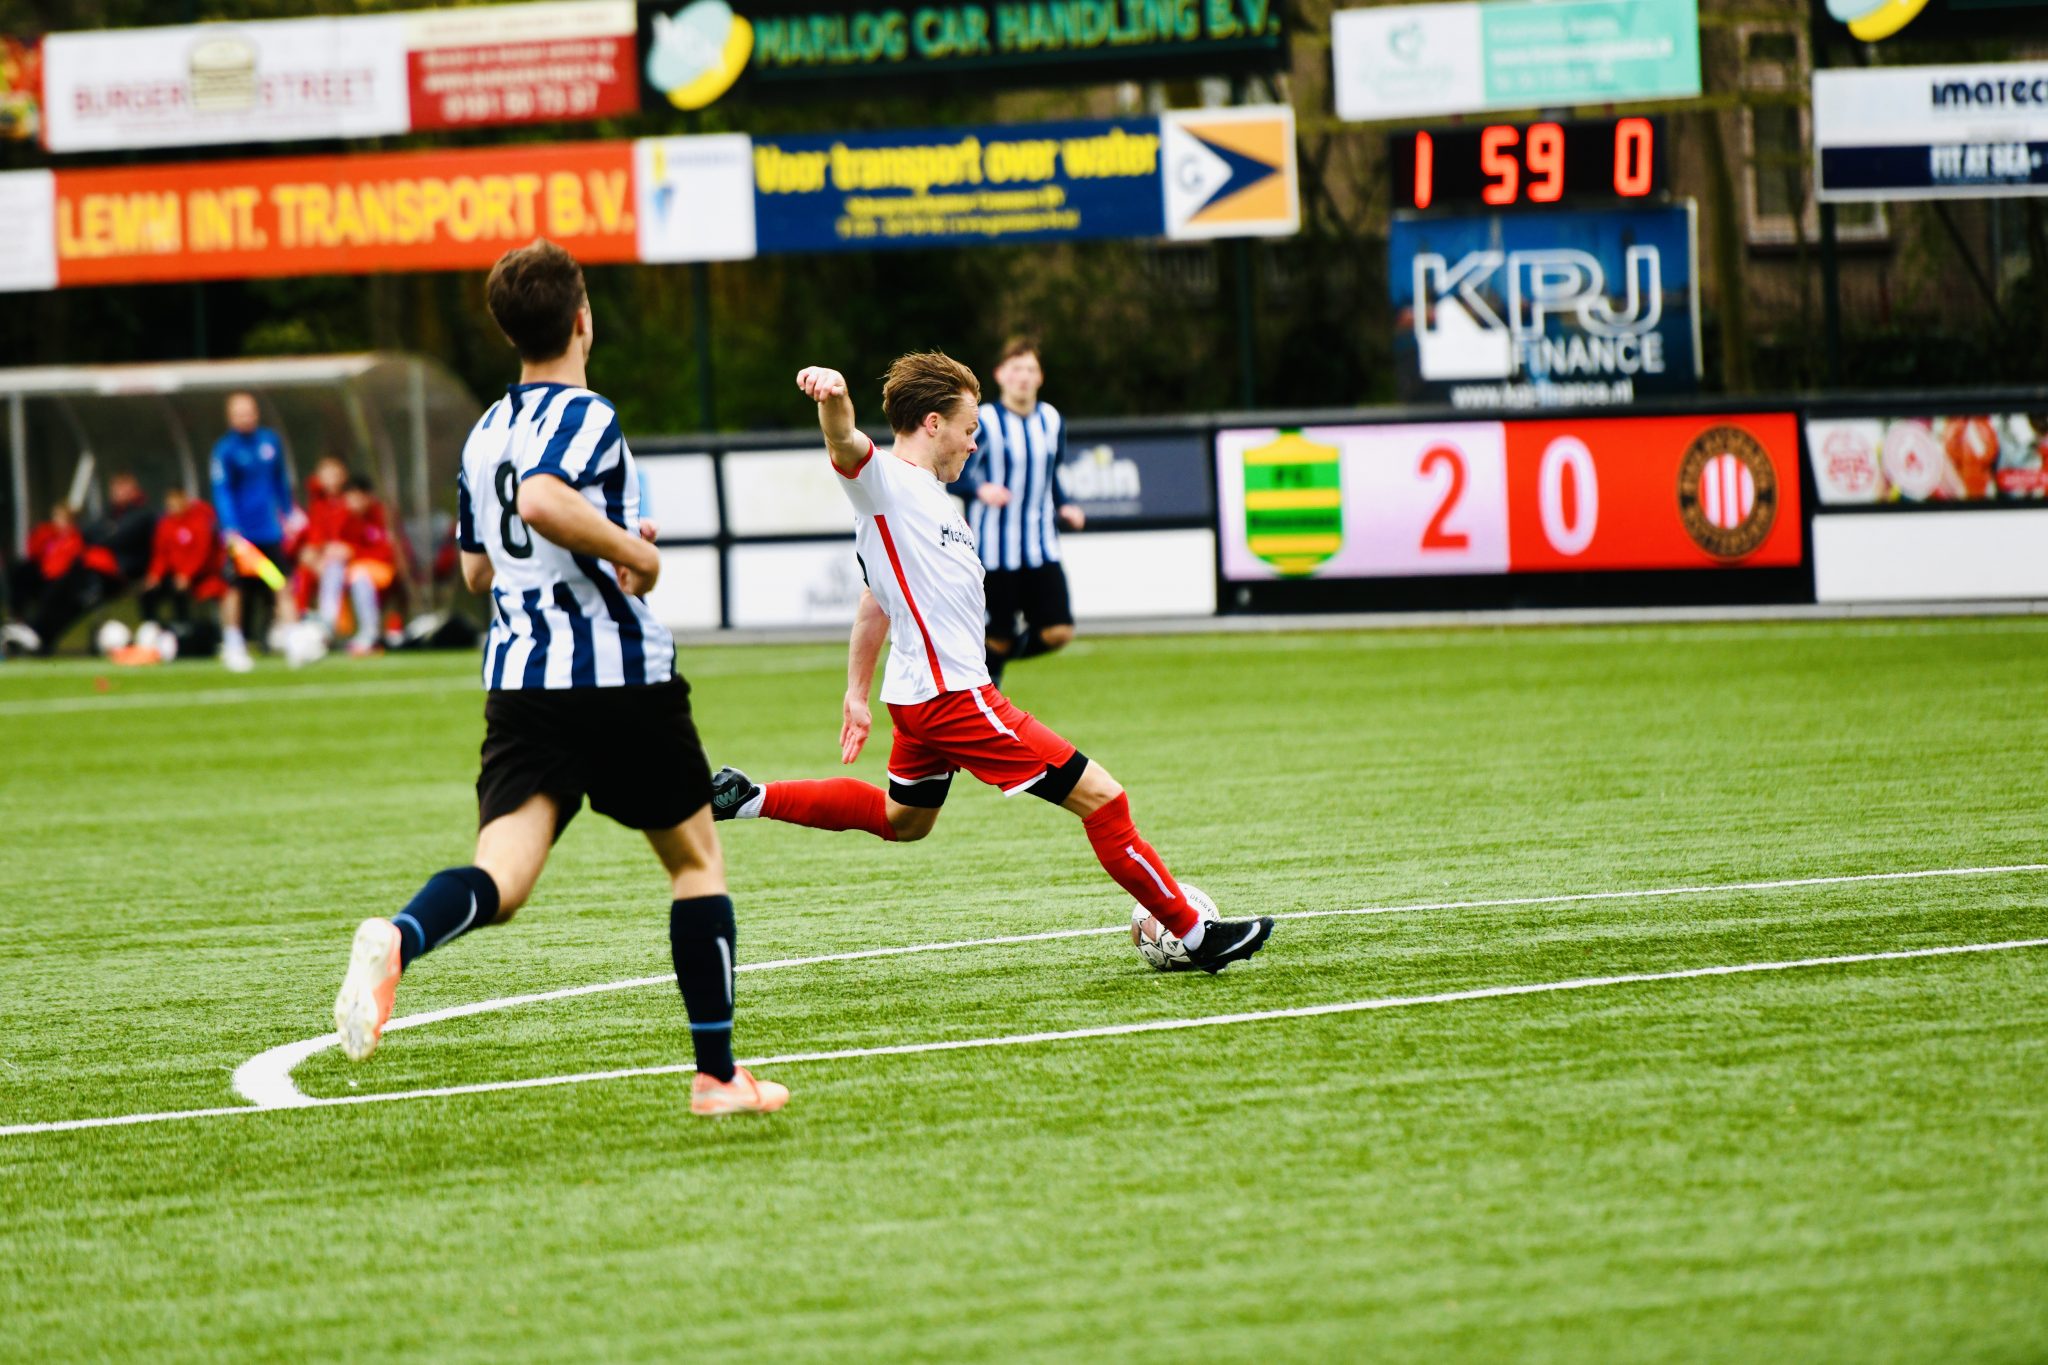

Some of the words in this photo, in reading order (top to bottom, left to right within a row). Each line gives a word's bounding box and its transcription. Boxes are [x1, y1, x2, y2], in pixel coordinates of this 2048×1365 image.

[754, 9, 906, 66] MARLOG
[913, 5, 990, 58] CAR
[996, 0, 1198, 51] HANDLING
[1204, 0, 1281, 39] B.V.
[261, 69, 375, 104] STREET
[754, 144, 828, 194] Voor
[830, 136, 982, 195] transport
[984, 139, 1058, 184] over
[1060, 127, 1159, 178] water
[1481, 122, 1565, 205] 59
[1613, 117, 1654, 197] 0
[188, 185, 267, 253] INT.
[270, 172, 542, 246] TRANSPORT
[547, 168, 635, 237] B.V.
[1413, 245, 1662, 338] KPJ
[1511, 332, 1665, 376] FINANCE
[495, 460, 533, 559] 8
[1417, 445, 1470, 550] 2
[1539, 436, 1599, 556] 0
